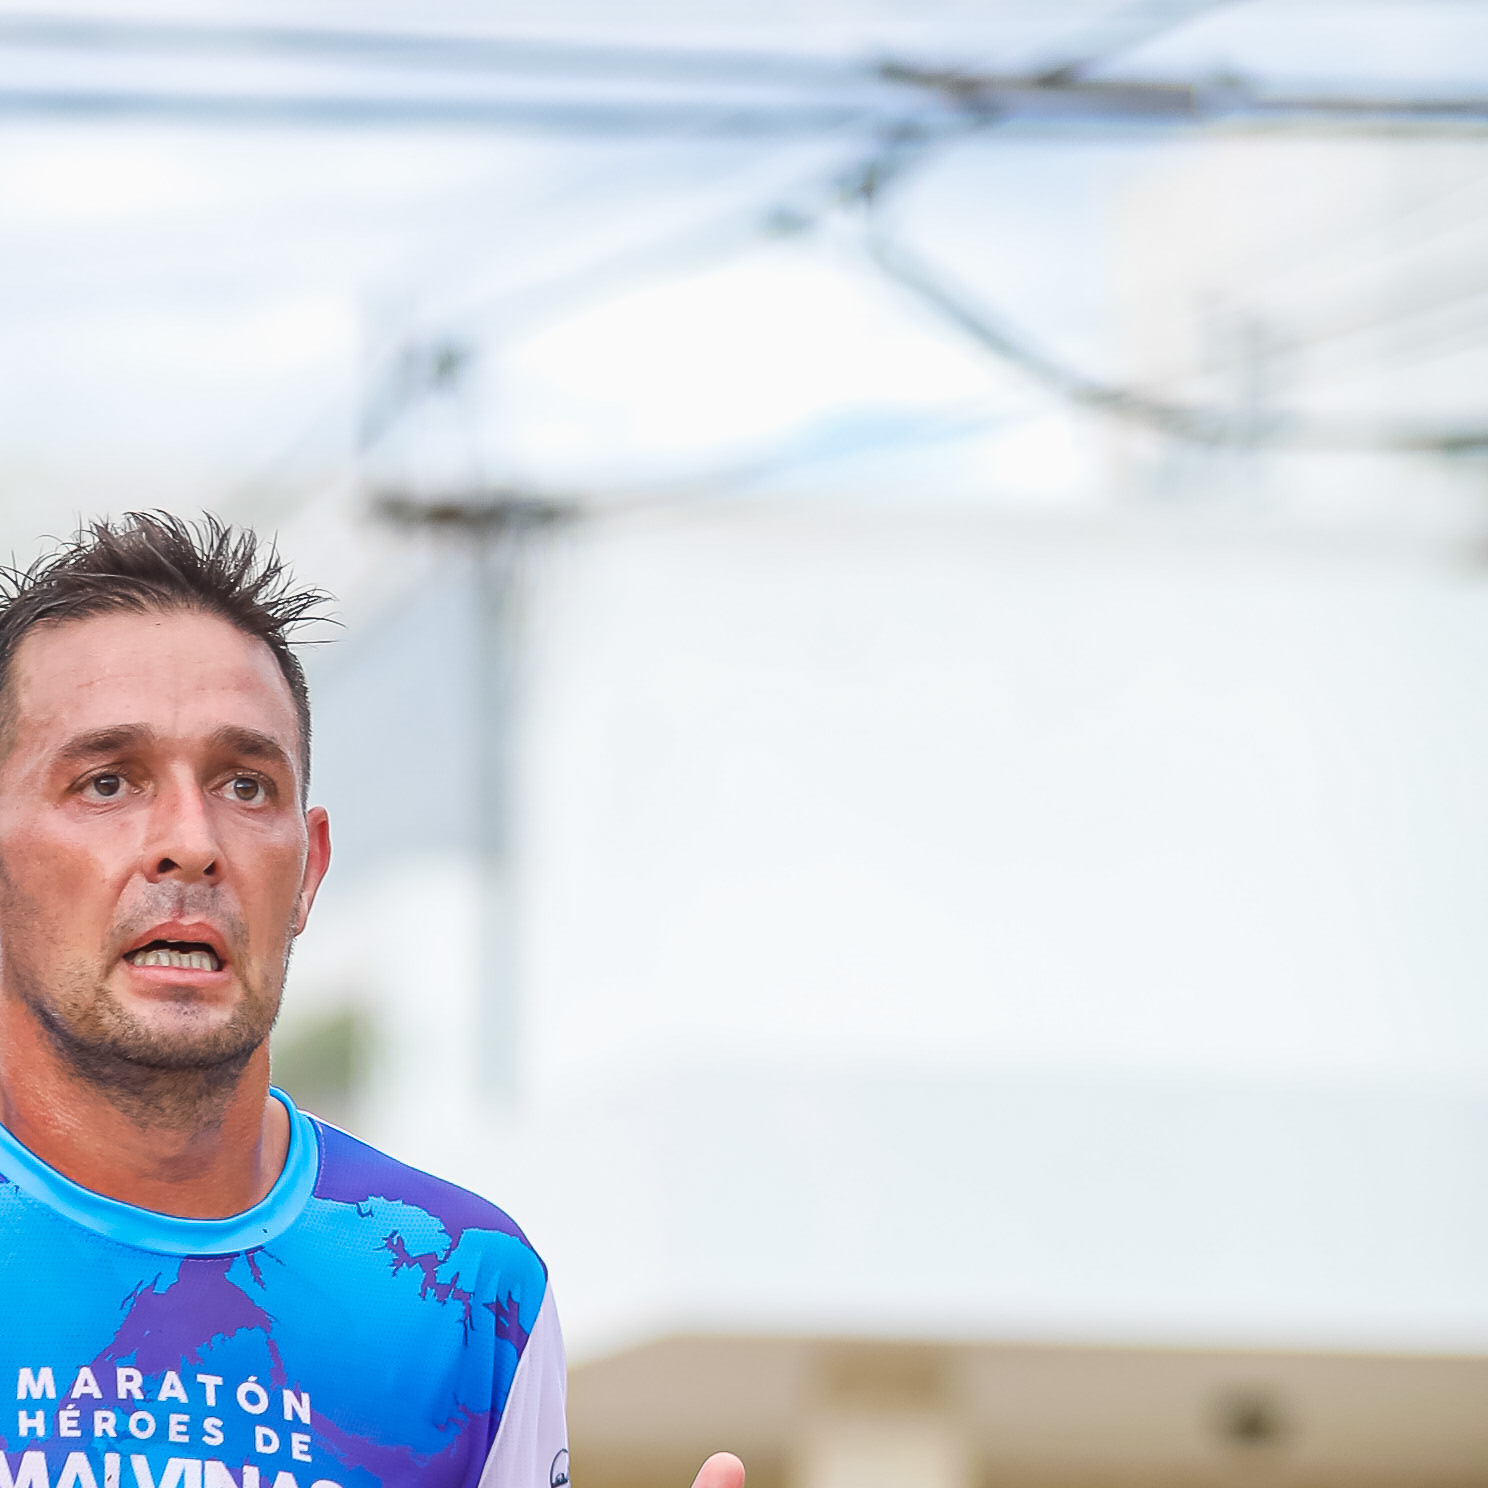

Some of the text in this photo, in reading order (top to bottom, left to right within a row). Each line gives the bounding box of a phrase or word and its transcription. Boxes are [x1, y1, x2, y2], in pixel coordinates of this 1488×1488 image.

[15, 1366, 312, 1425] MARATÓN
[17, 1403, 313, 1463] HÉROES DE
